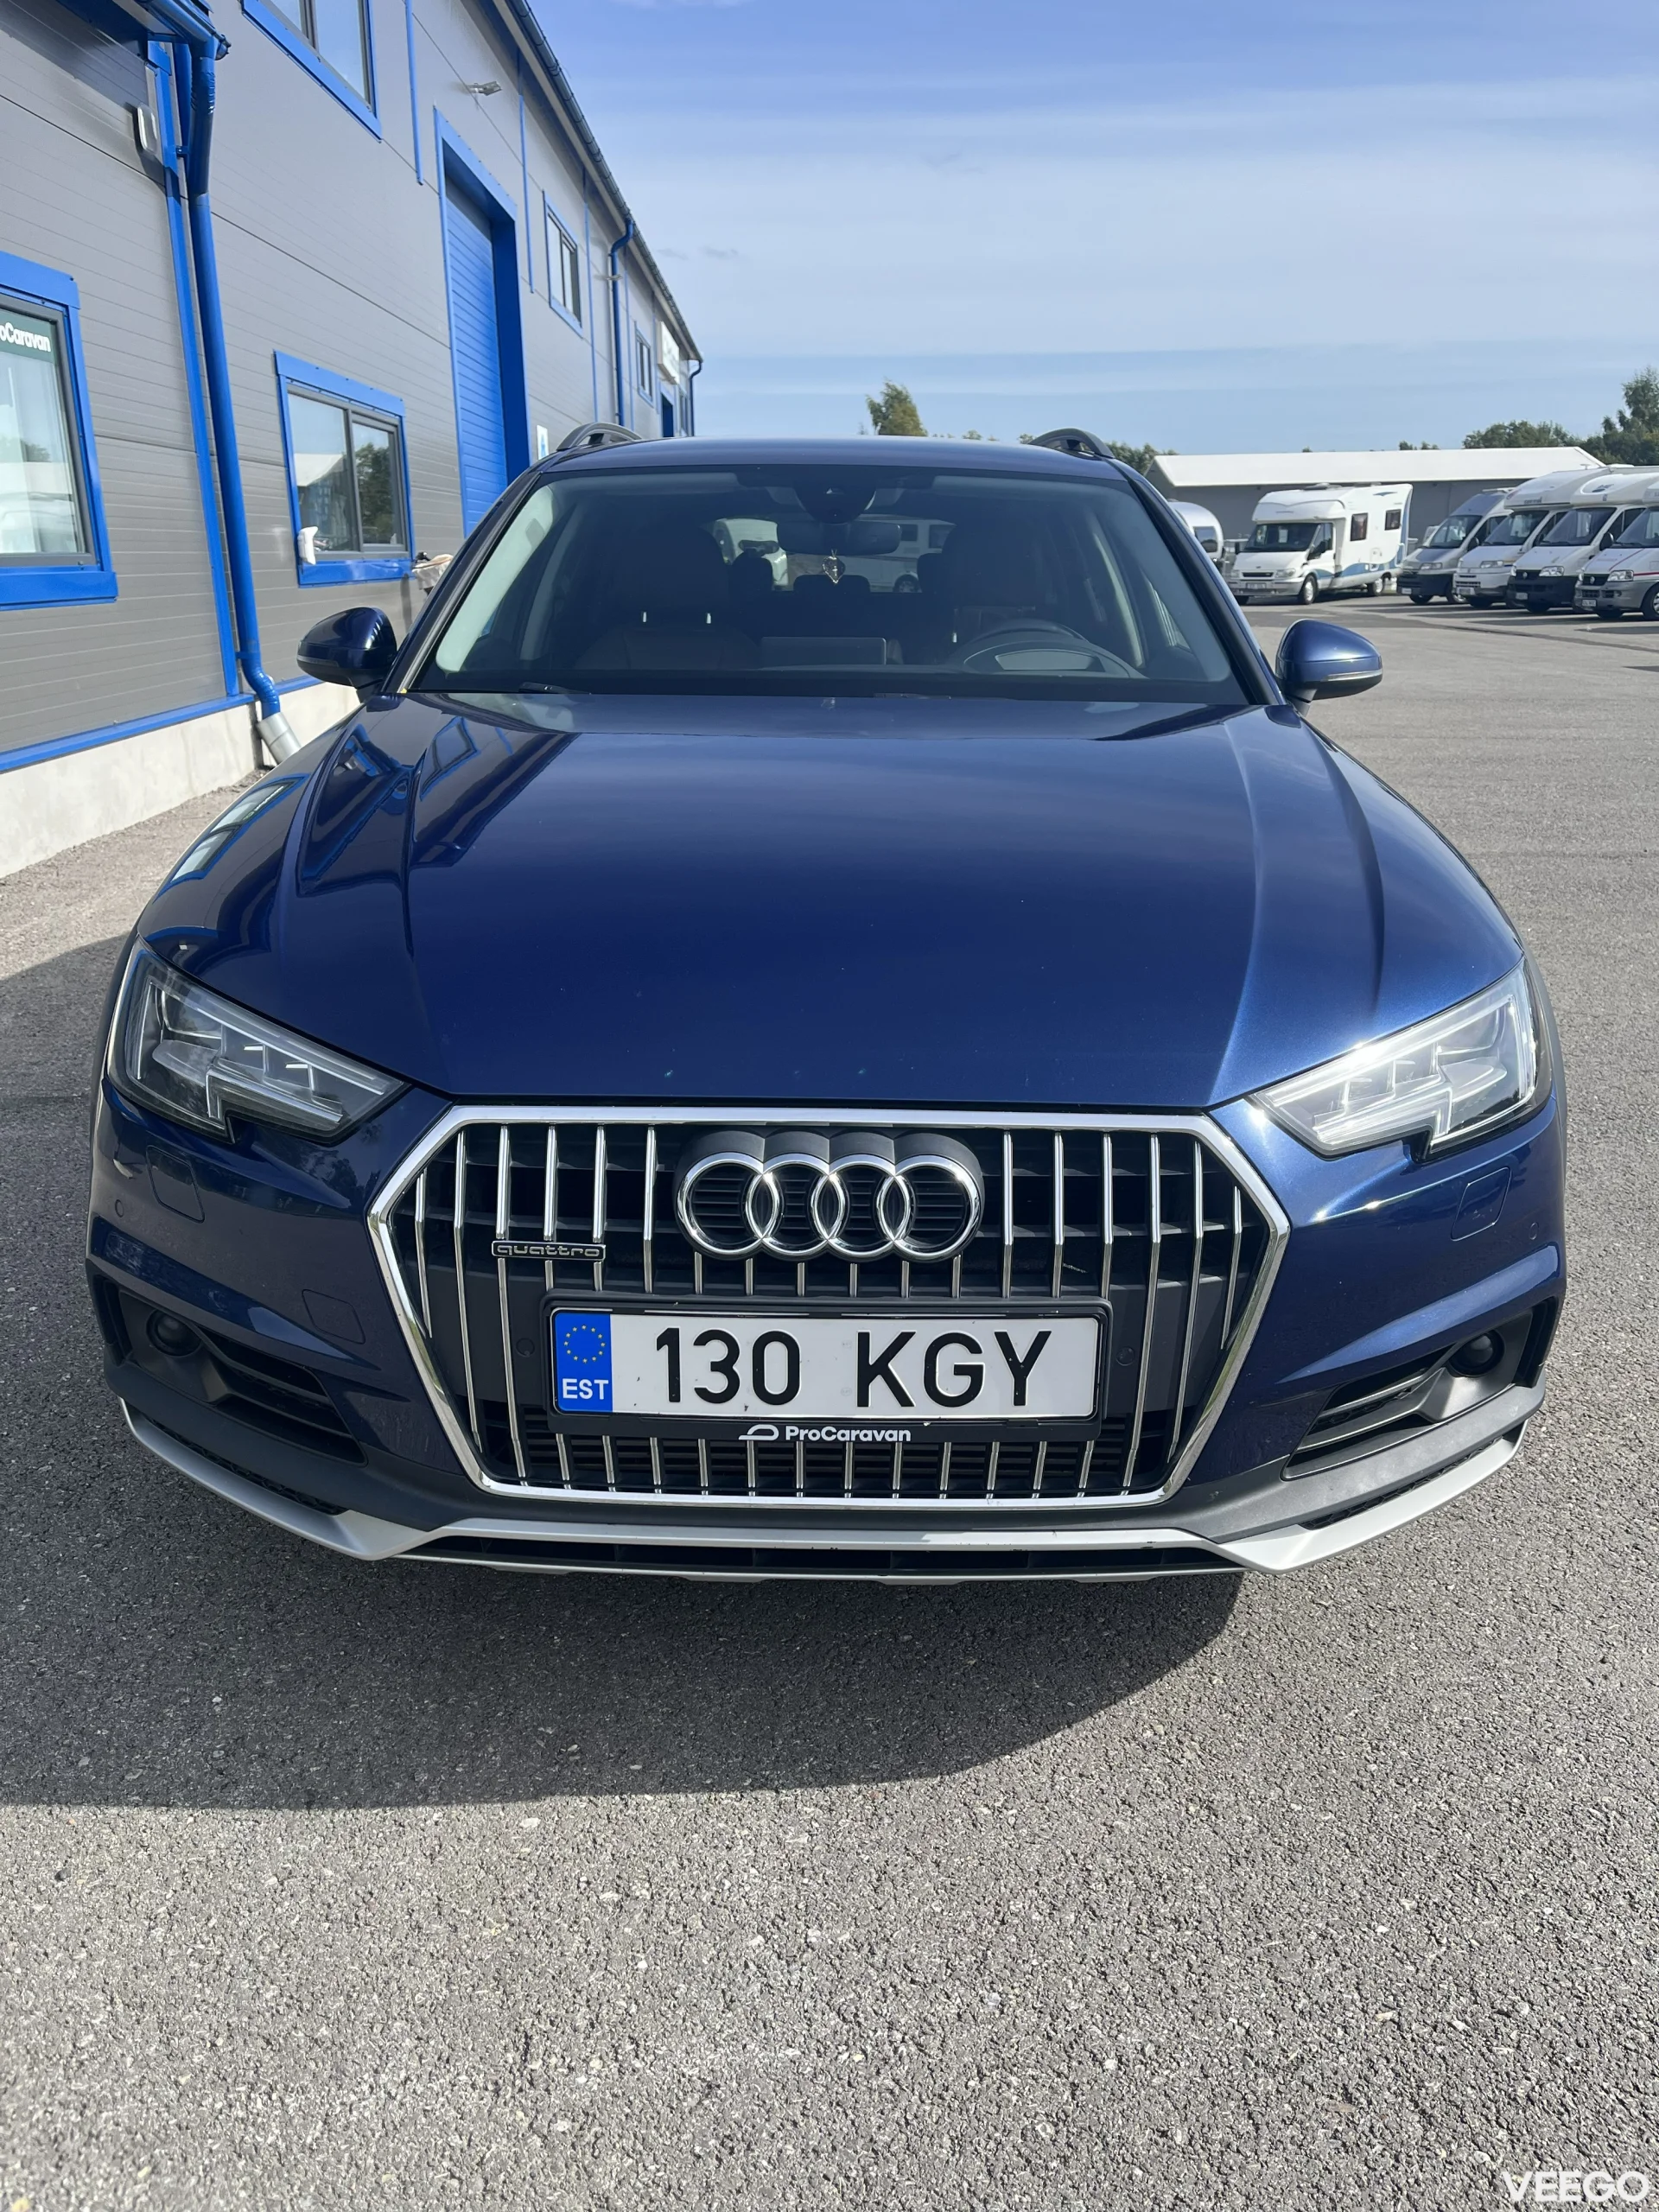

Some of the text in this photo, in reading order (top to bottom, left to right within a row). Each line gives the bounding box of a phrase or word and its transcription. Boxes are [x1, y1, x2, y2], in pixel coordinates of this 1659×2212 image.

[497, 1245, 600, 1256] quattro
[656, 1327, 1052, 1408] 130 KGY
[562, 1378, 609, 1400] EST
[785, 1426, 911, 1442] ProCaravan
